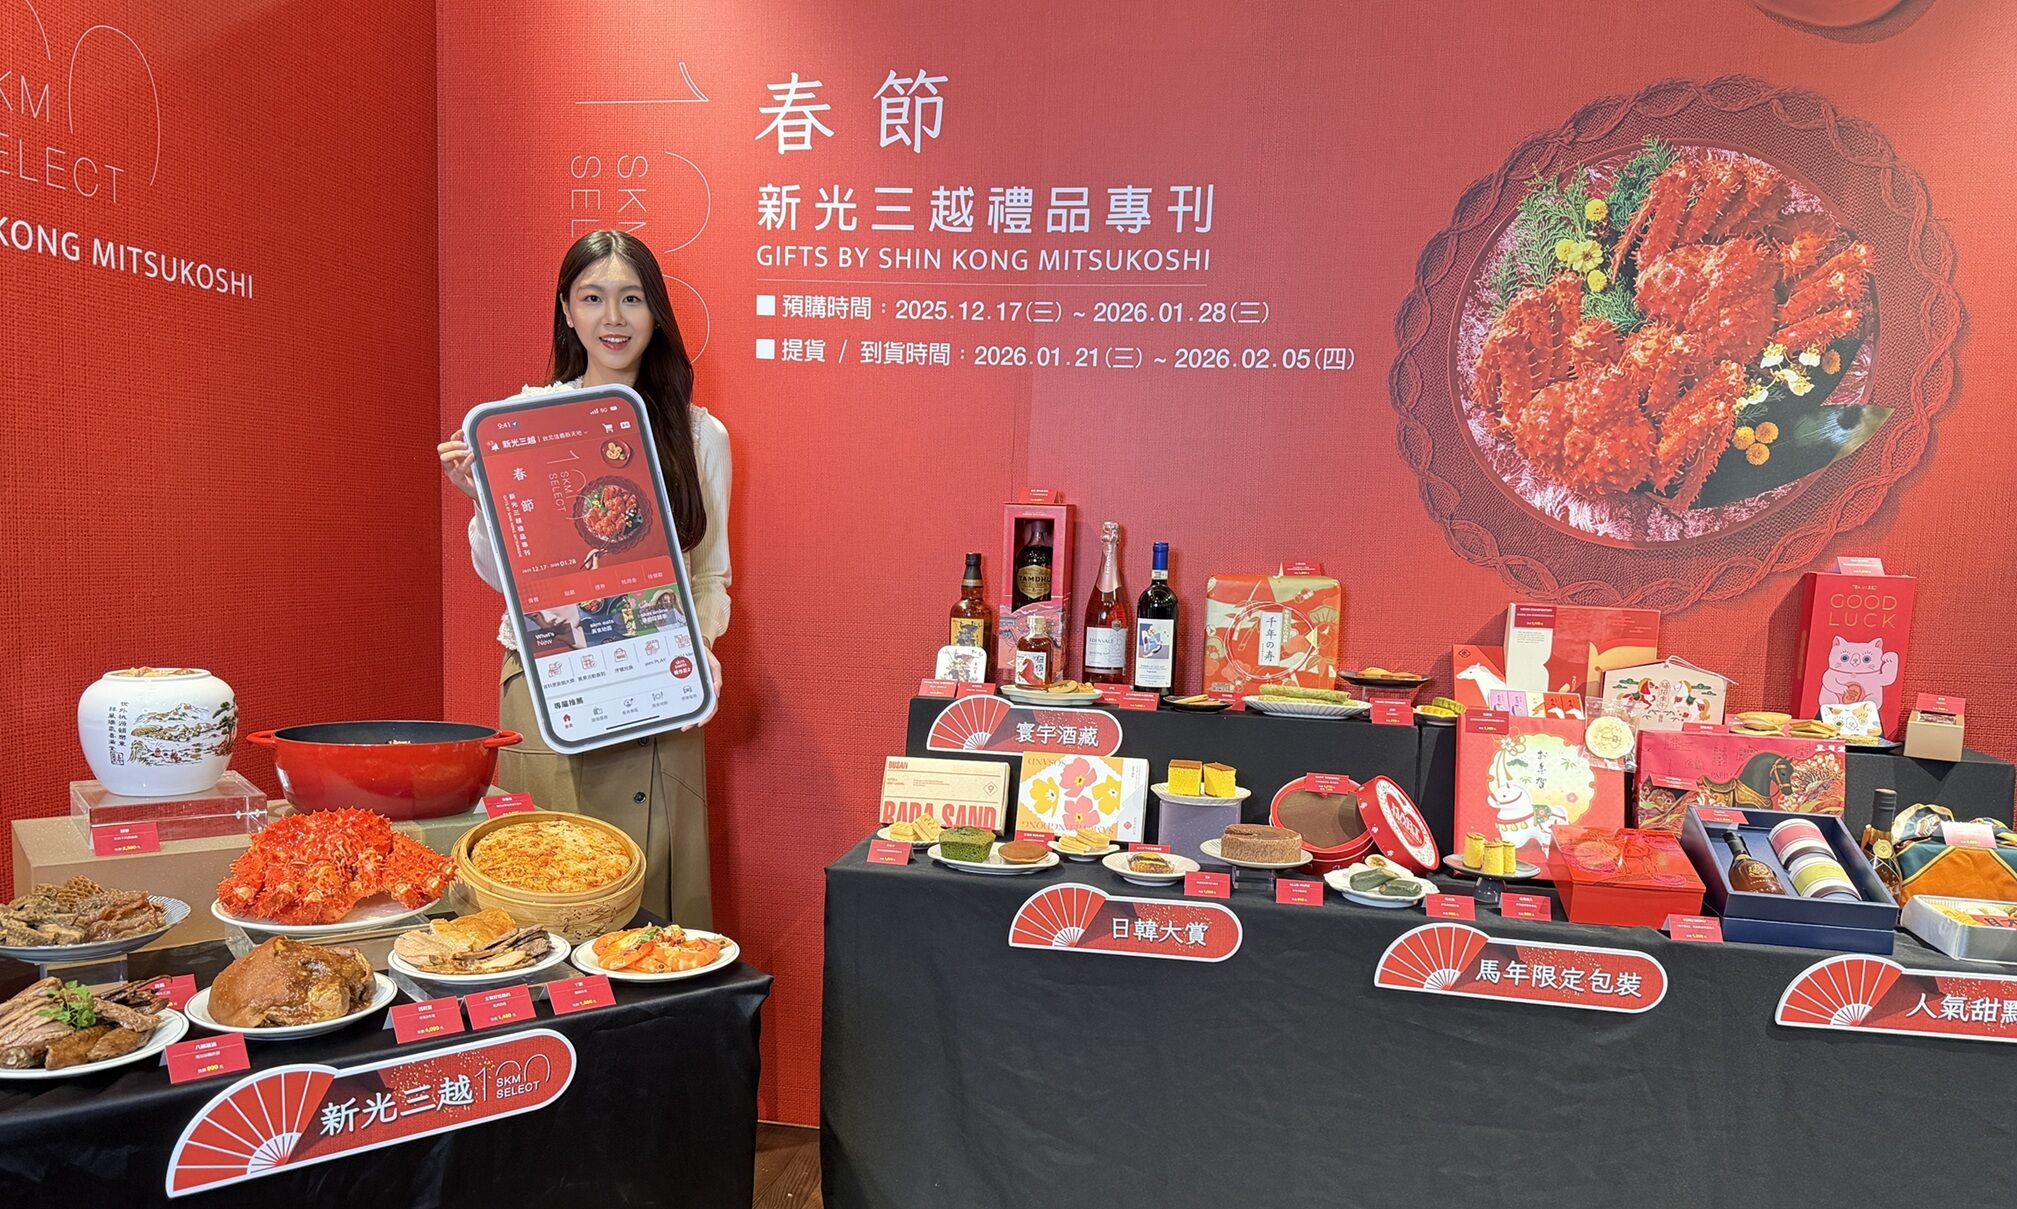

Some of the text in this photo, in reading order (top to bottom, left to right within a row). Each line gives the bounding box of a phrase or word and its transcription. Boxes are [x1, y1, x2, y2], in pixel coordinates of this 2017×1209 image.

[757, 183, 1214, 234] 新光三越禮品專刊
[92, 238, 253, 299] MITSUKOSHI
[756, 245, 1210, 272] GIFTS BY SHIN KONG MITSUKOSHI
[781, 338, 826, 363] 提貨
[548, 473, 567, 512] SELECT
[560, 471, 574, 494] SKM
[1830, 593, 1897, 611] GOOD
[1828, 611, 1897, 629] LUCK
[1264, 616, 1278, 662] 千年の寿
[1015, 721, 1099, 747] 寰宇酒藏
[888, 760, 909, 770] BUSAN
[941, 803, 997, 832] SAND
[1112, 917, 1209, 946] 日韓大賞
[1475, 958, 1643, 998] 馬年限定包裝
[496, 1073, 522, 1088] SKM
[496, 1080, 540, 1100] SELECT
[319, 1073, 474, 1136] 新光三越
